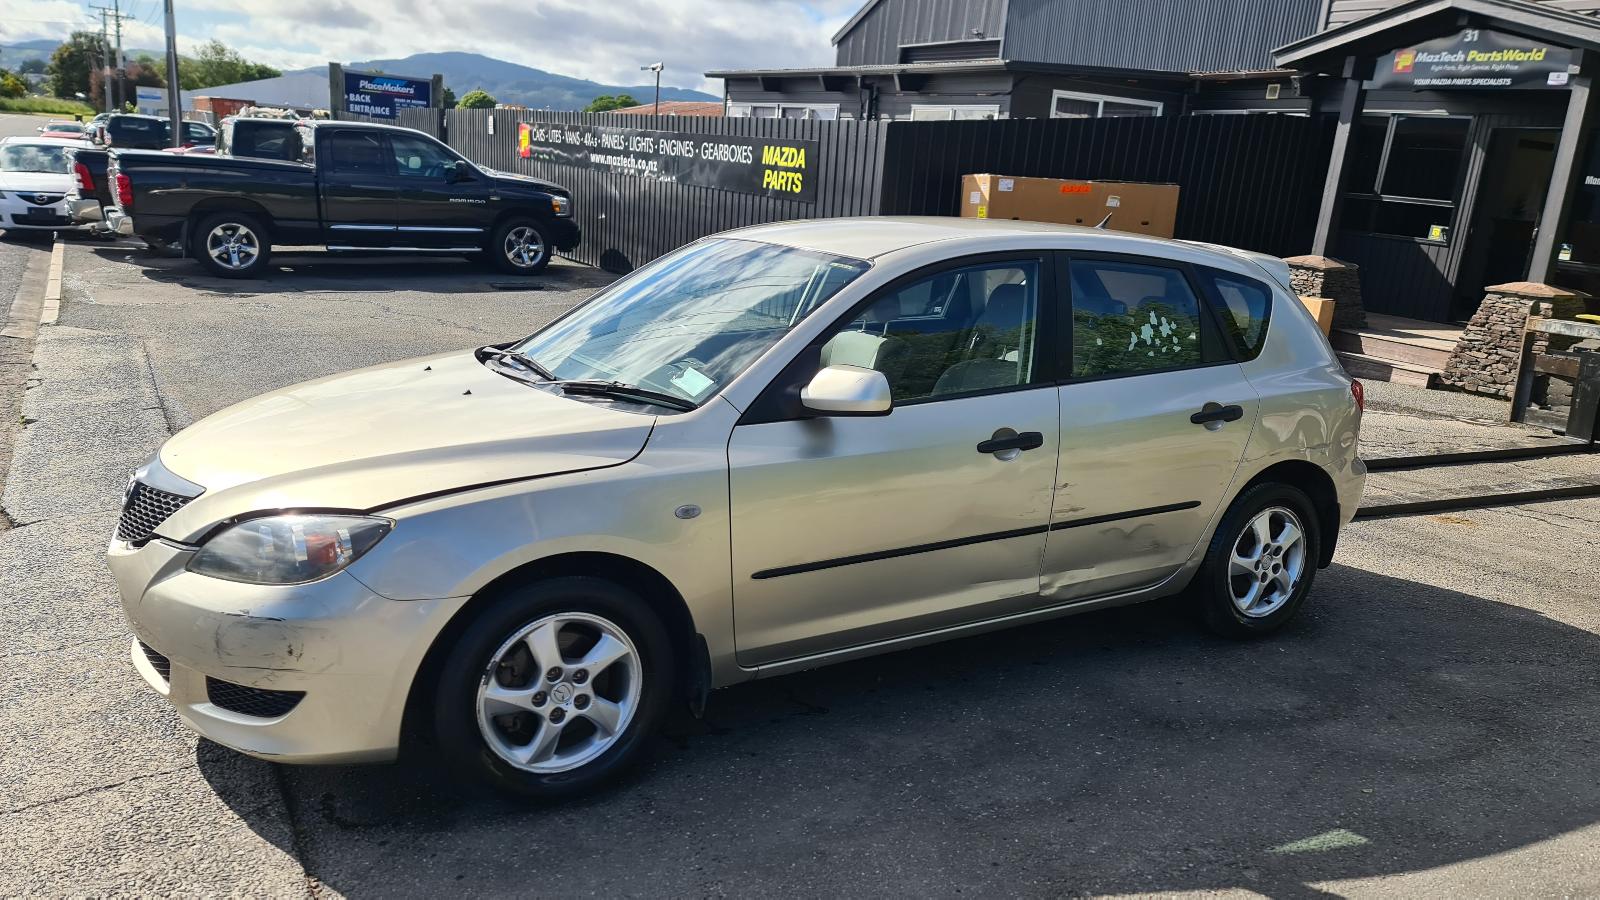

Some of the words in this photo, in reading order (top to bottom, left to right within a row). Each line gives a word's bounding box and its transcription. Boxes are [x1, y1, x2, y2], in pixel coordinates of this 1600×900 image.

[1463, 29, 1479, 42] 31
[1415, 51, 1465, 62] MazTech
[1467, 48, 1547, 61] PartsWorld
[359, 80, 415, 94] PlaceMakers
[1414, 78, 1431, 86] YOUR
[1430, 78, 1451, 86] MAZDA
[1451, 78, 1472, 86] PARTS
[1471, 78, 1512, 86] SPECIALISTS
[349, 93, 371, 103] BACK
[349, 104, 390, 115] ENTRANCE
[532, 128, 546, 142] CARS
[548, 129, 562, 143] UTES
[565, 131, 580, 146] VANS
[601, 134, 625, 150] PANELS
[629, 136, 654, 154] LIGHTS
[659, 139, 694, 158] ENGINES
[701, 142, 753, 164] GEARBOXES
[590, 153, 658, 172] www.maztech.co.nz
[762, 145, 806, 169] MAZDA
[762, 169, 803, 193] PARTS
